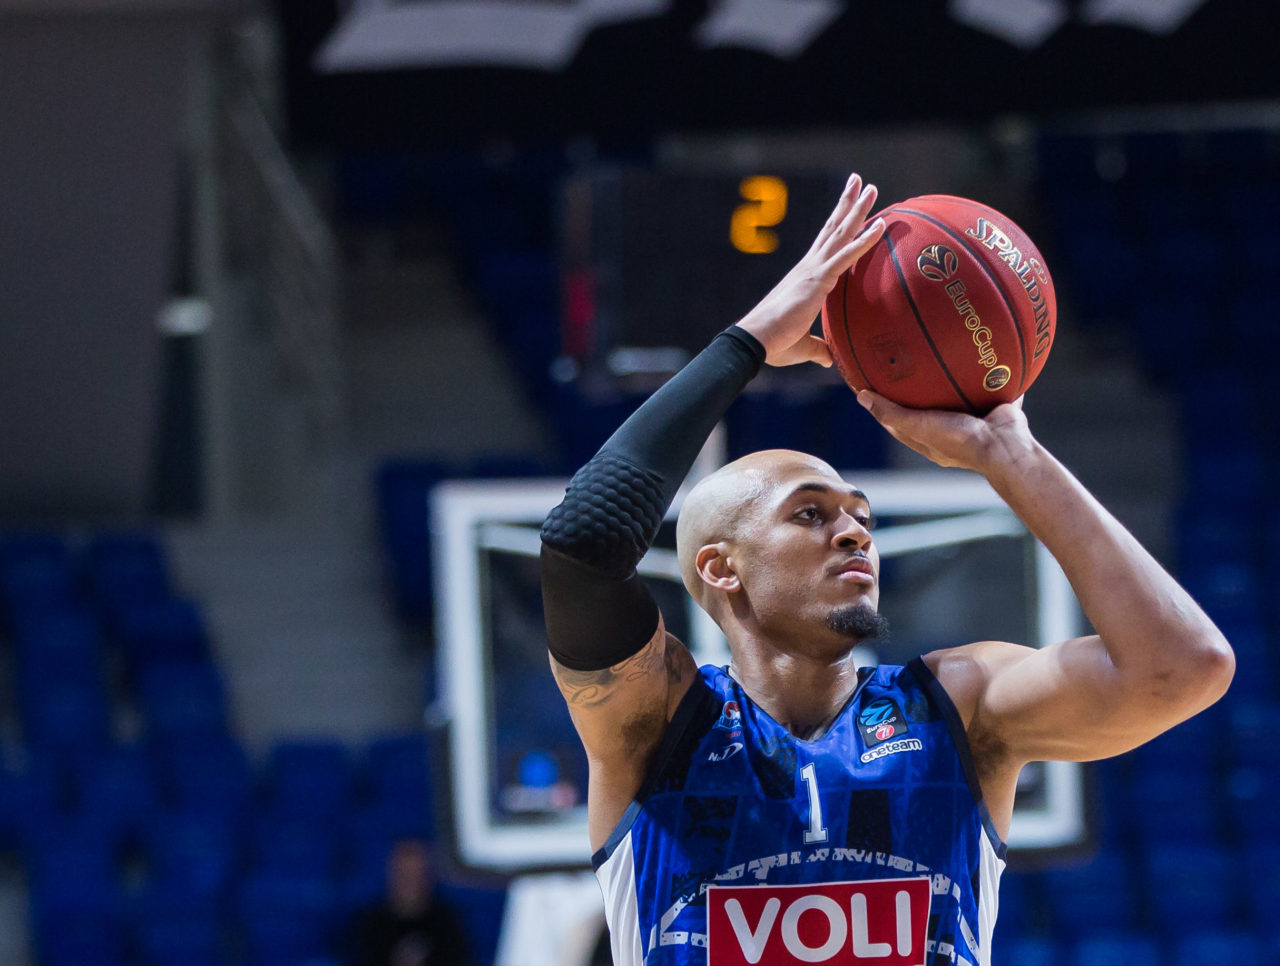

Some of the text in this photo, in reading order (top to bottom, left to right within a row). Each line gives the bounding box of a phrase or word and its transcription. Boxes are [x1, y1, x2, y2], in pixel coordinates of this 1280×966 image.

[730, 175, 788, 253] 2
[945, 279, 998, 368] EuroCup
[965, 217, 1052, 360] SPALDING
[866, 716, 897, 734] EuroCup
[801, 762, 829, 844] 1
[724, 890, 913, 965] VOLI
